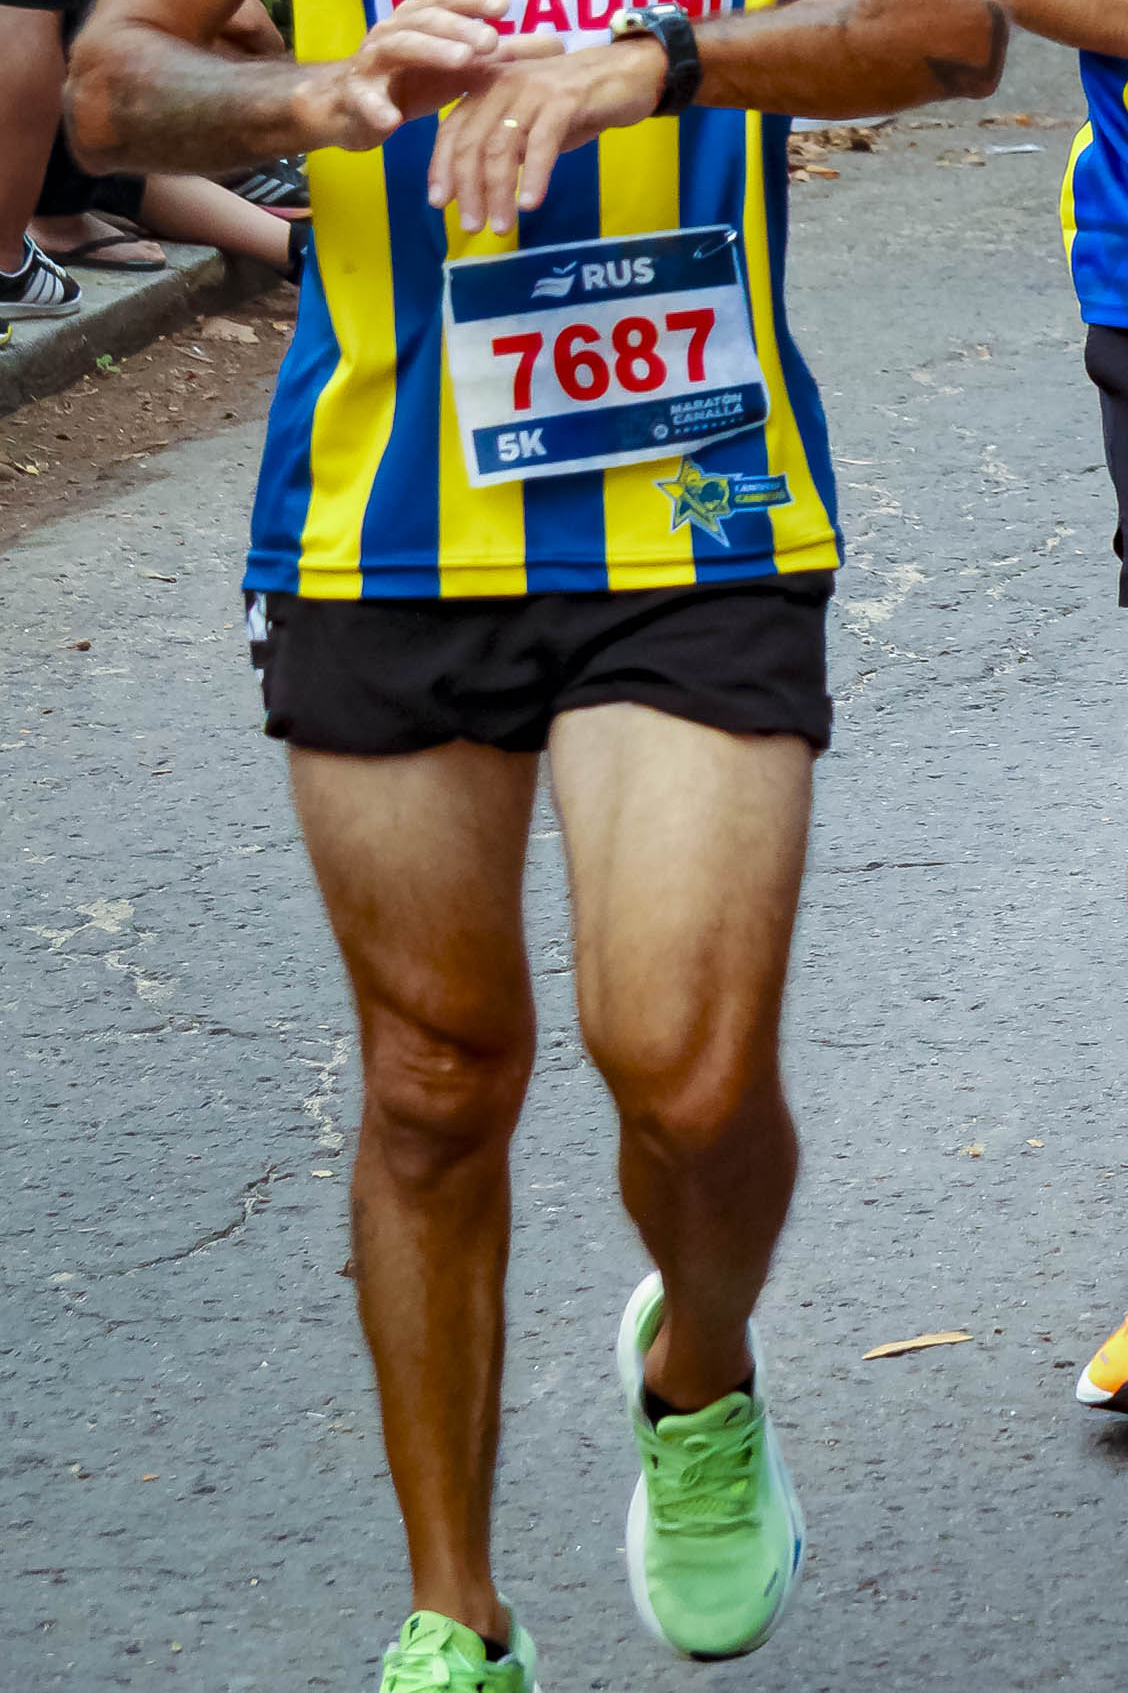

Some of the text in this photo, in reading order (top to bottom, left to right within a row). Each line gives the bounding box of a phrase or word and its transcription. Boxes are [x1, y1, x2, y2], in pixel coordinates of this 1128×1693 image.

[581, 256, 656, 292] RUS
[491, 307, 716, 411] 7687
[670, 391, 743, 416] MARATÓN
[673, 403, 745, 426] CANALLA
[496, 426, 548, 463] 5K
